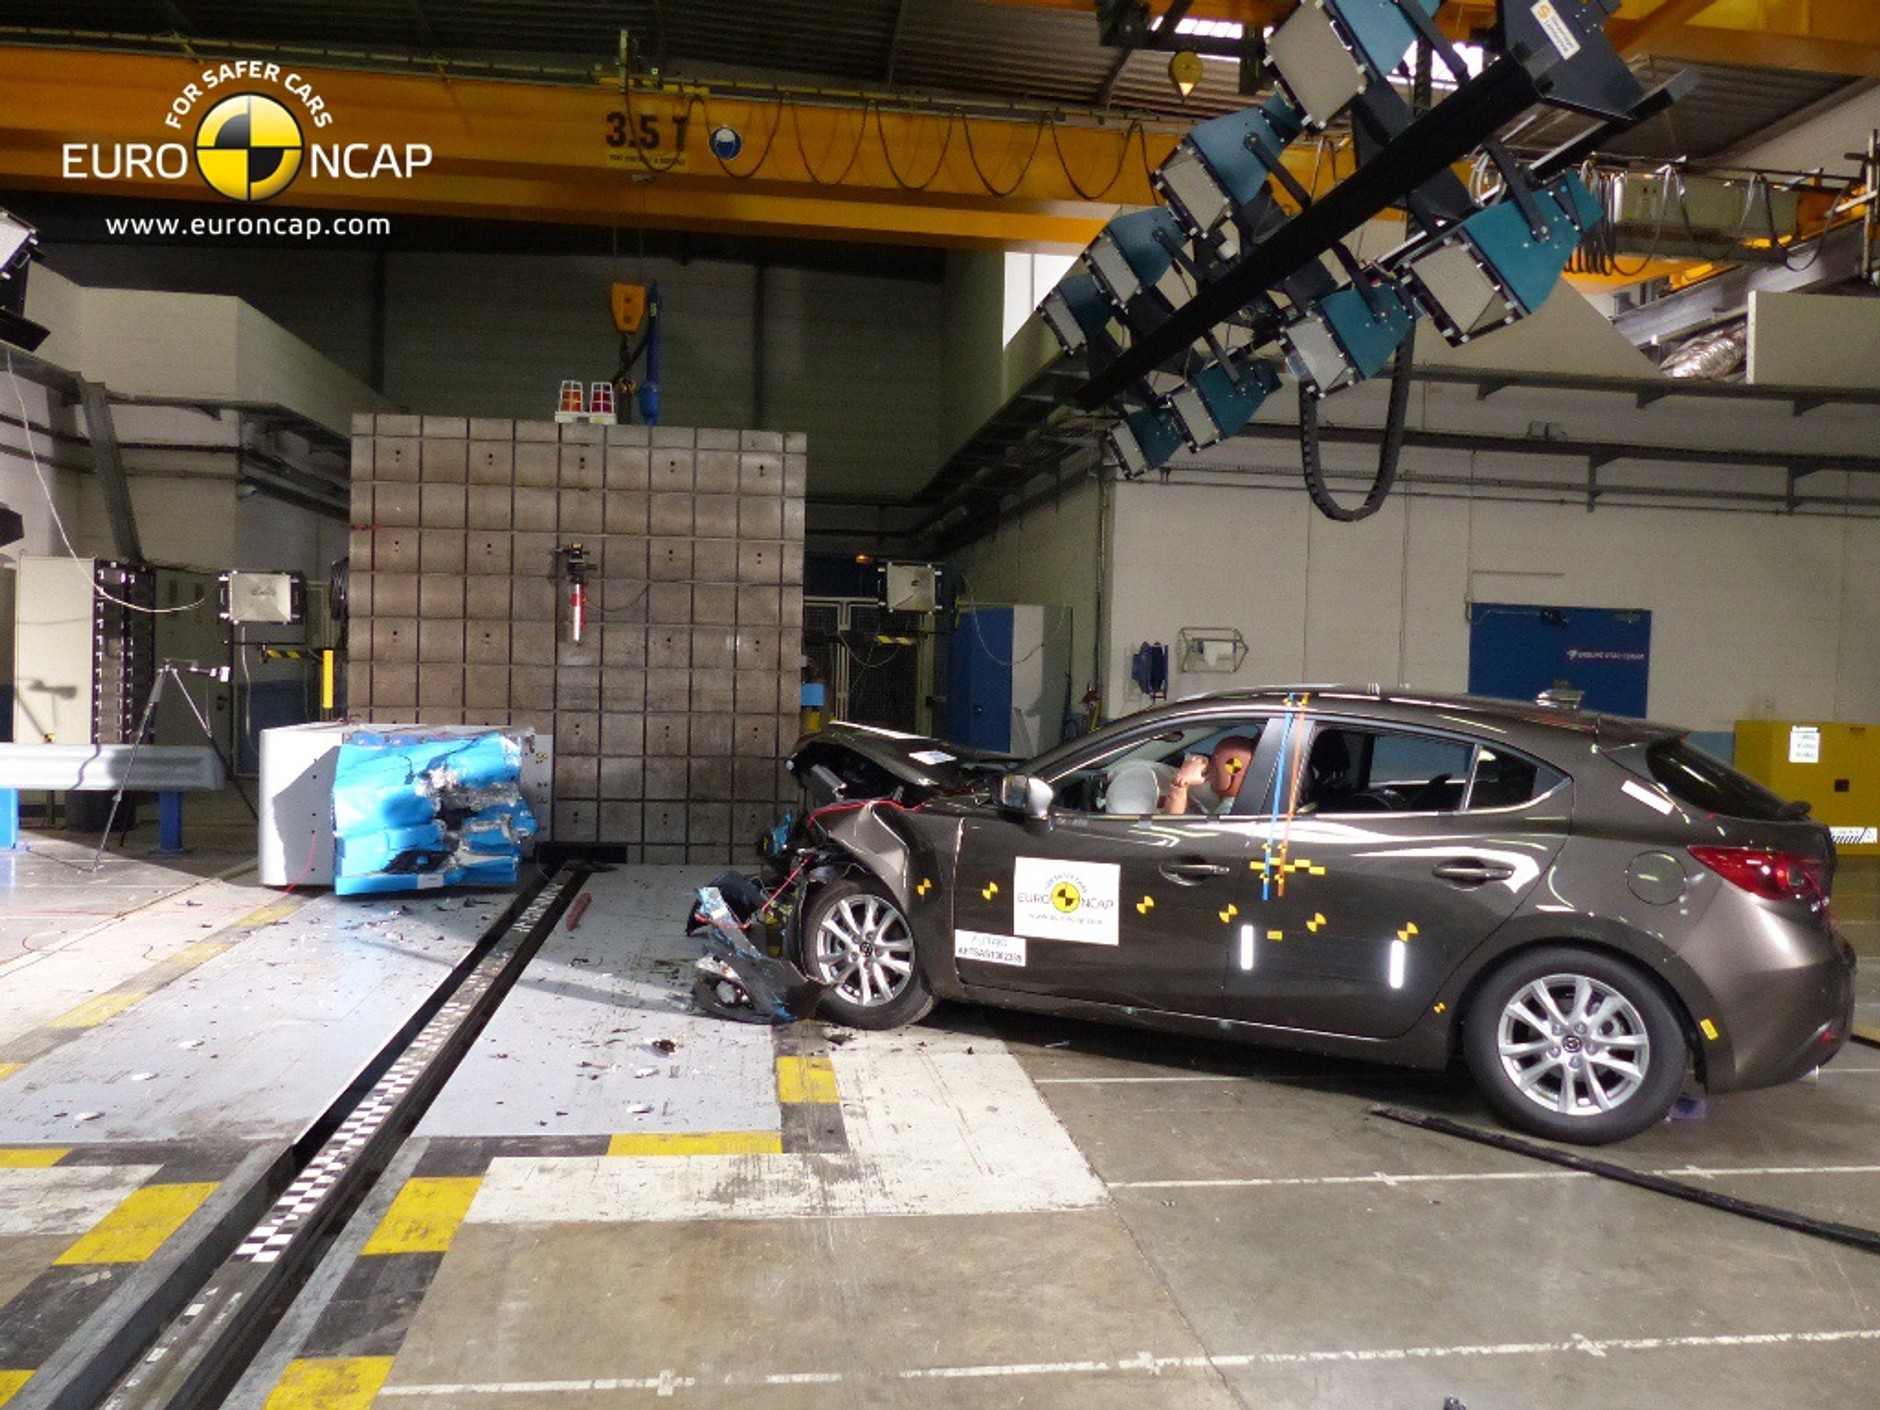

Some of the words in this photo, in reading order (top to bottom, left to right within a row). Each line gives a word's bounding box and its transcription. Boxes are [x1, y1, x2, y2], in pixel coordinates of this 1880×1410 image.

[606, 111, 660, 150] 3.5
[1017, 892, 1051, 905] EURO
[1081, 897, 1114, 910] NCAP
